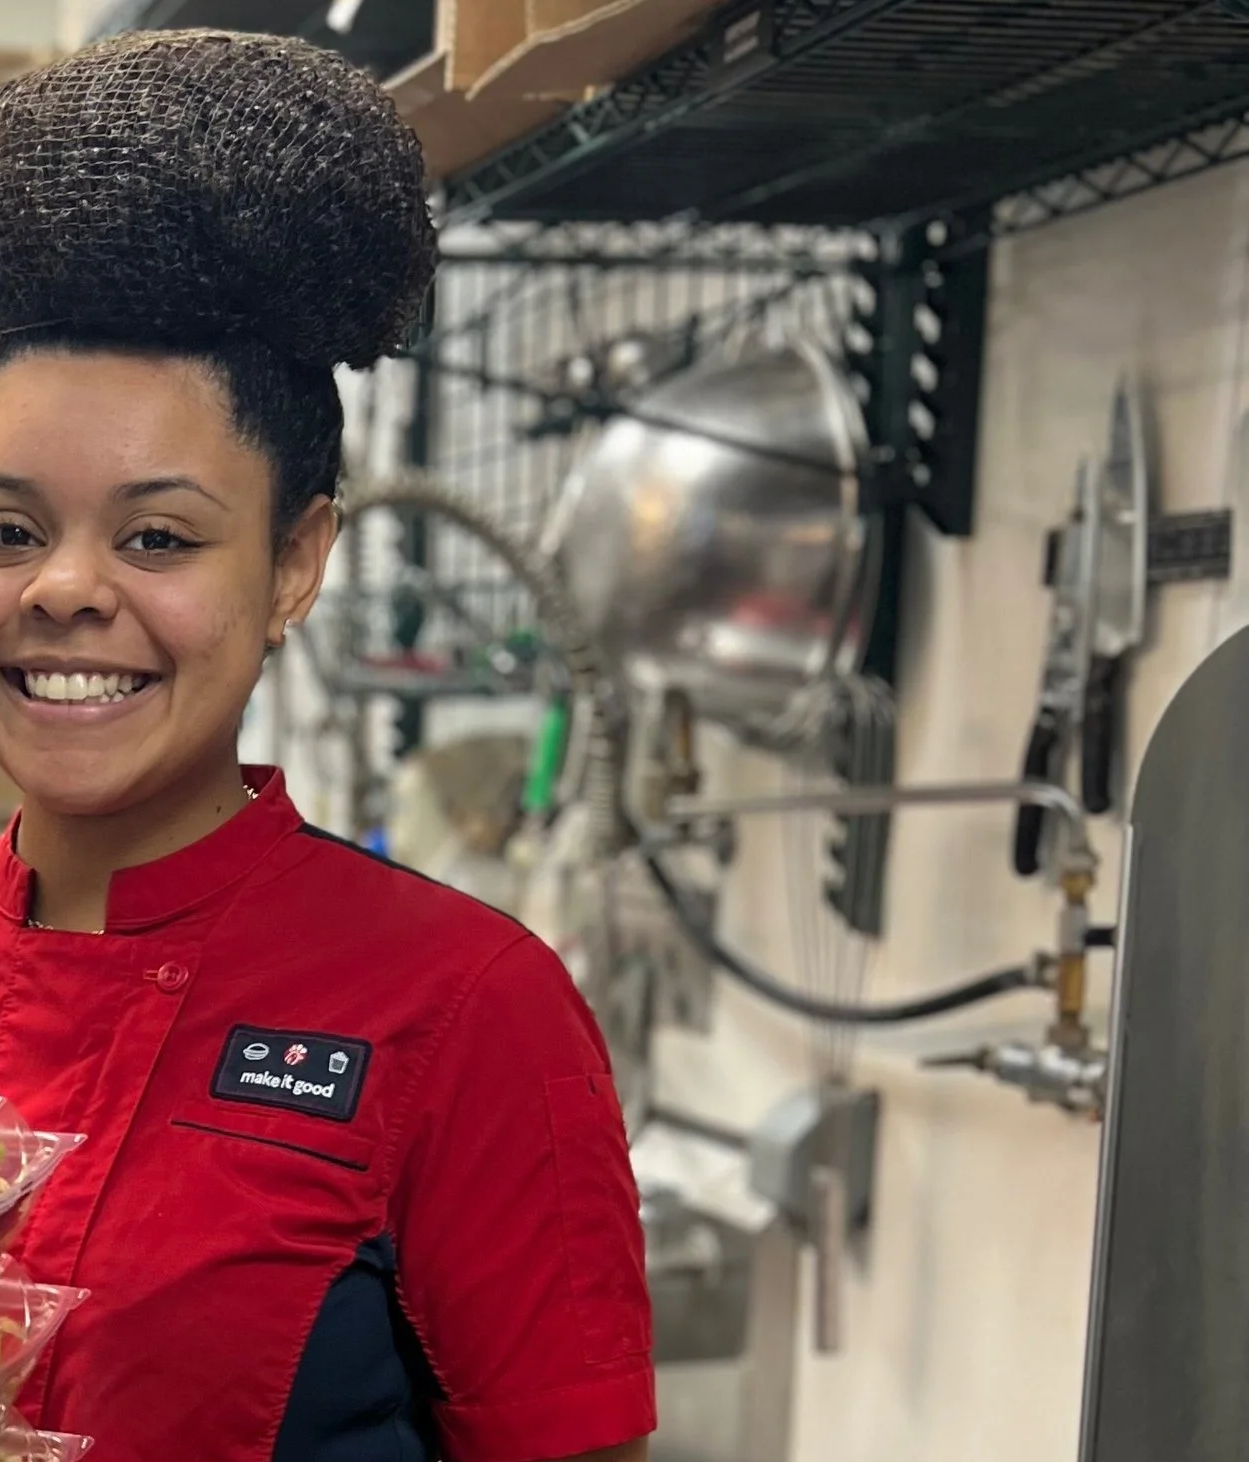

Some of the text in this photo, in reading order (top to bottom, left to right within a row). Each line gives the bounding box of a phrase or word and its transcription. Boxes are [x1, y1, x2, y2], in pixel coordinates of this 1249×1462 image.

[240, 1071, 335, 1098] make it good
